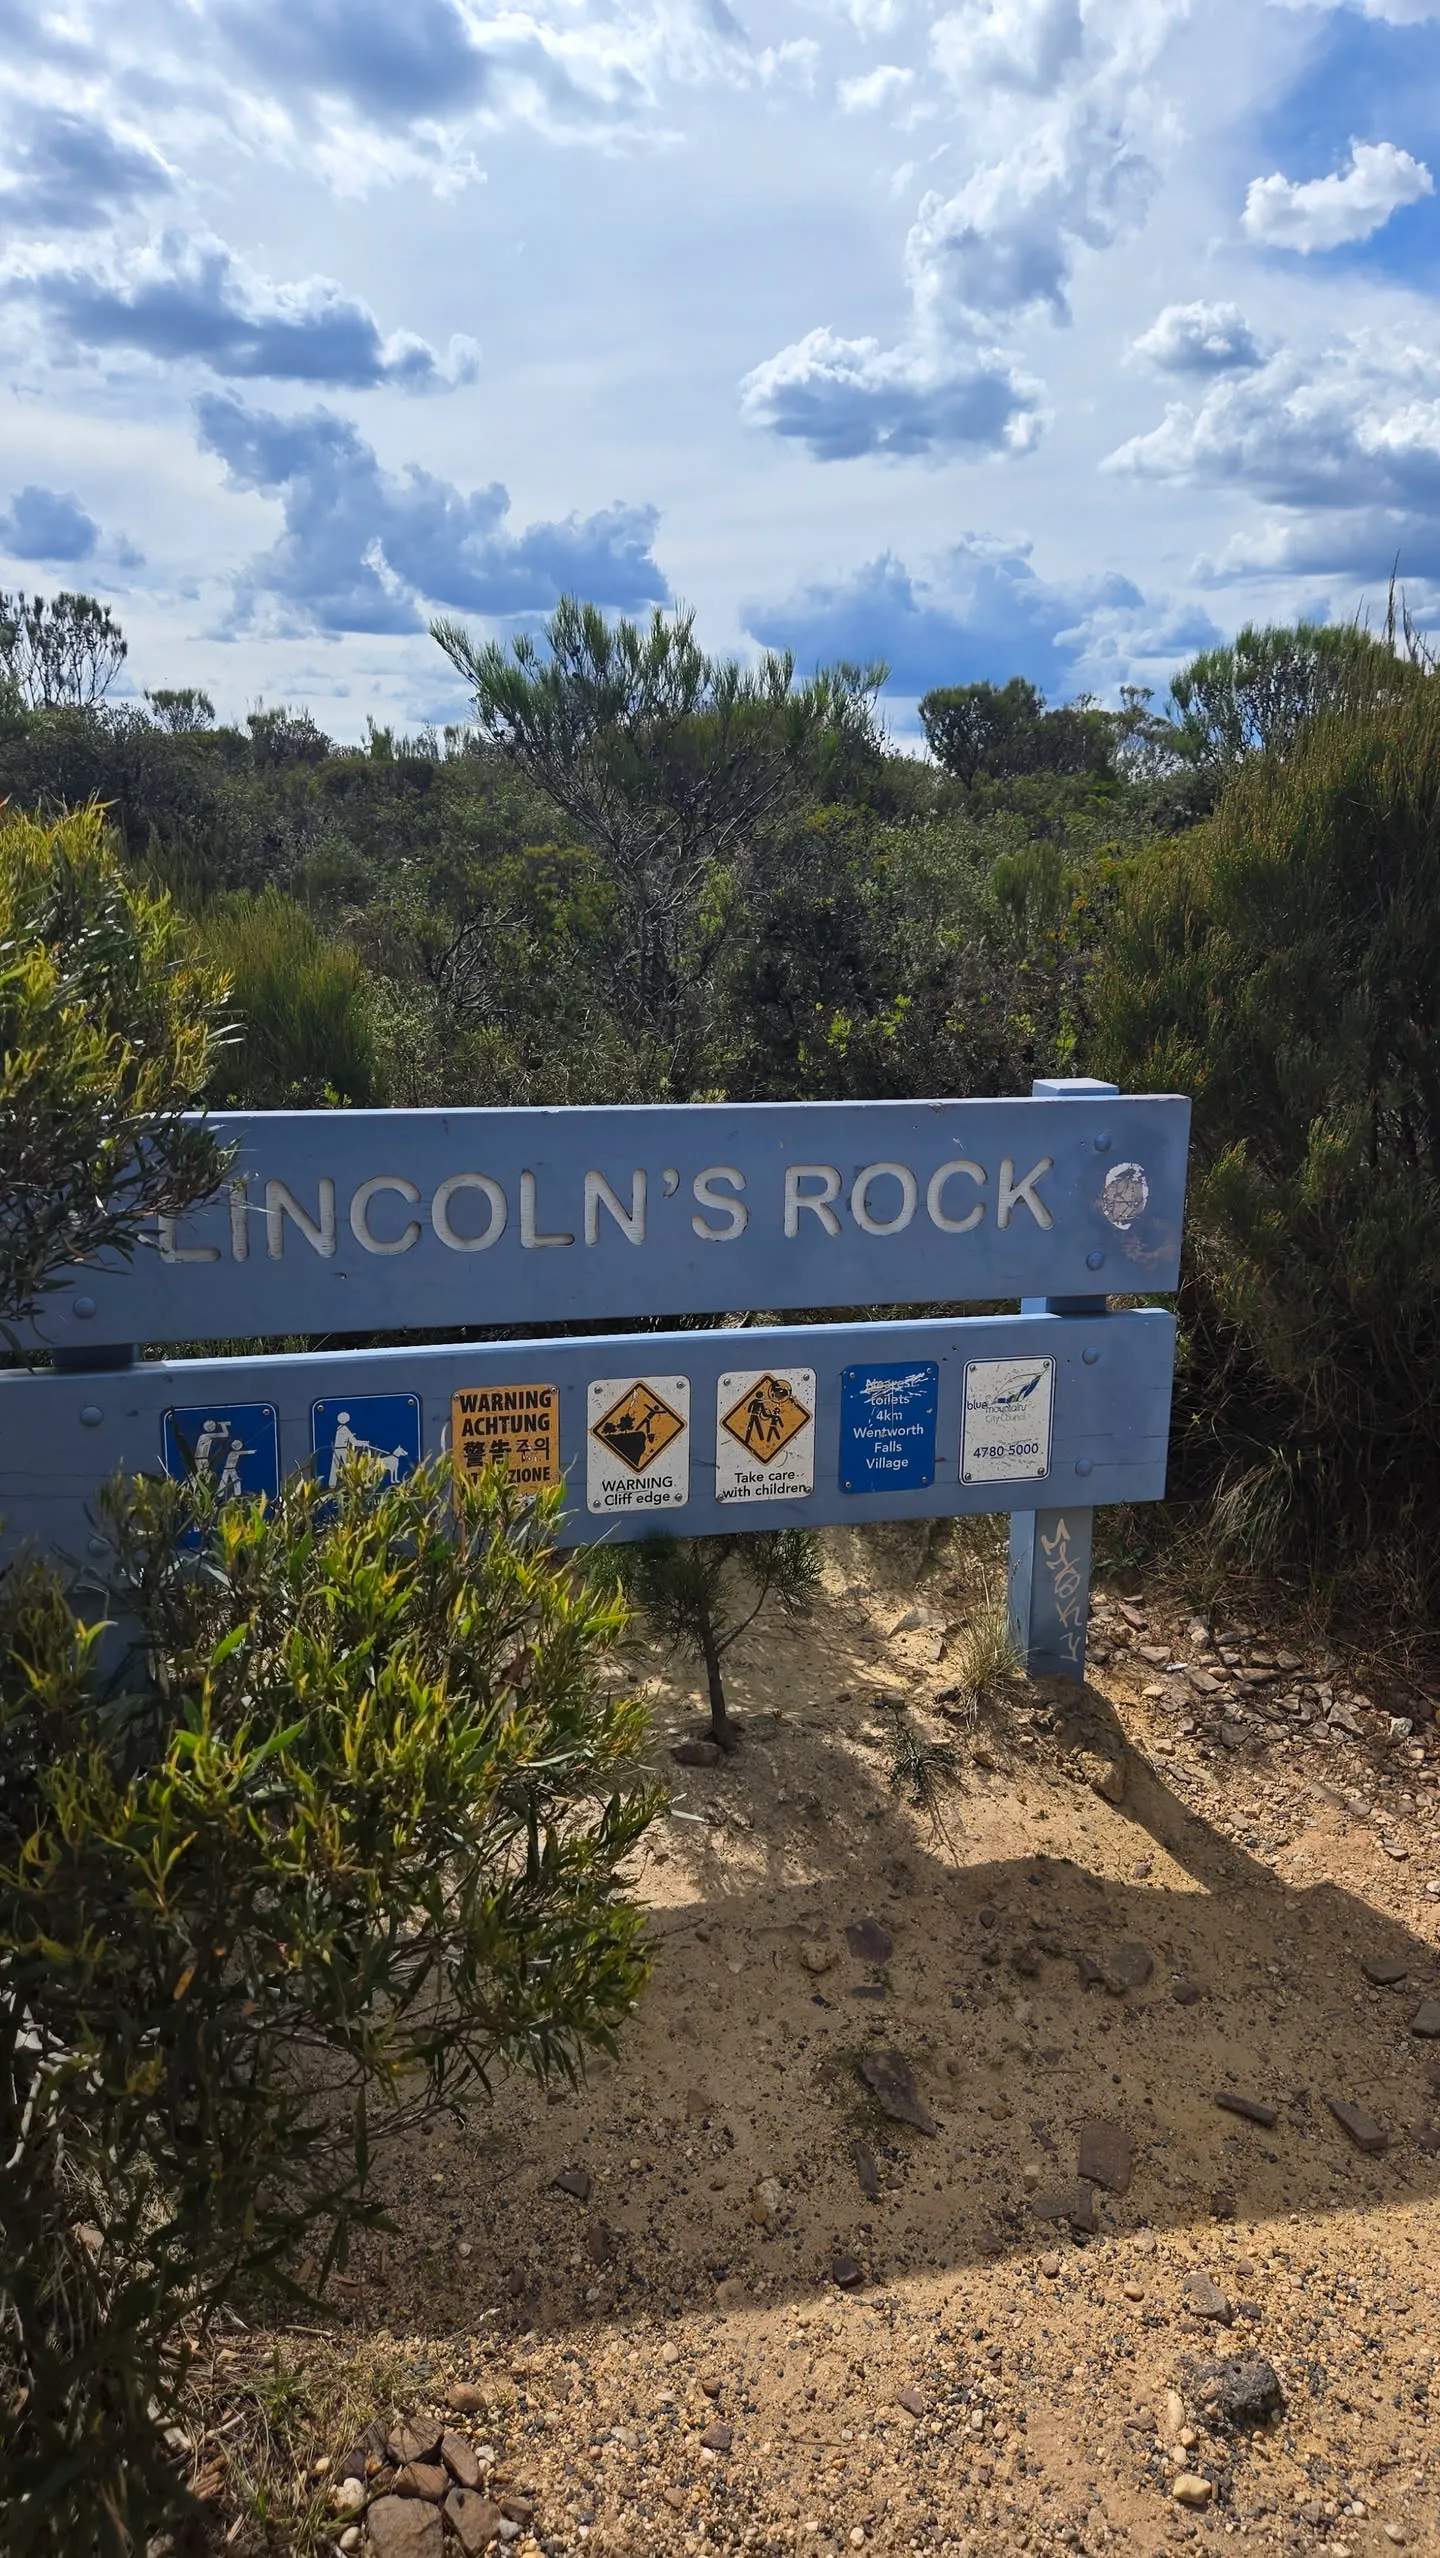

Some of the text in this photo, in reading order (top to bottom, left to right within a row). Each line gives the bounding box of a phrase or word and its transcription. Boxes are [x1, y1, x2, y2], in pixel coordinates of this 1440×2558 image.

[158, 1156, 1055, 1264] LINCOLN'S ROCK
[460, 1389, 552, 1414] WARNING
[871, 1393, 910, 1406] toilets
[967, 1400, 988, 1410] blue
[876, 1409, 903, 1421] 4km
[462, 1413, 550, 1437] ACHTUNG
[853, 1424, 924, 1439] Wentworth
[874, 1442, 902, 1453] Falls
[973, 1443, 1039, 1459] 4780 5000
[866, 1457, 909, 1471] Village
[601, 1476, 673, 1492] WARNING
[734, 1471, 795, 1483] Take care
[722, 1482, 806, 1498] with children
[604, 1491, 670, 1506] Cliff edge
